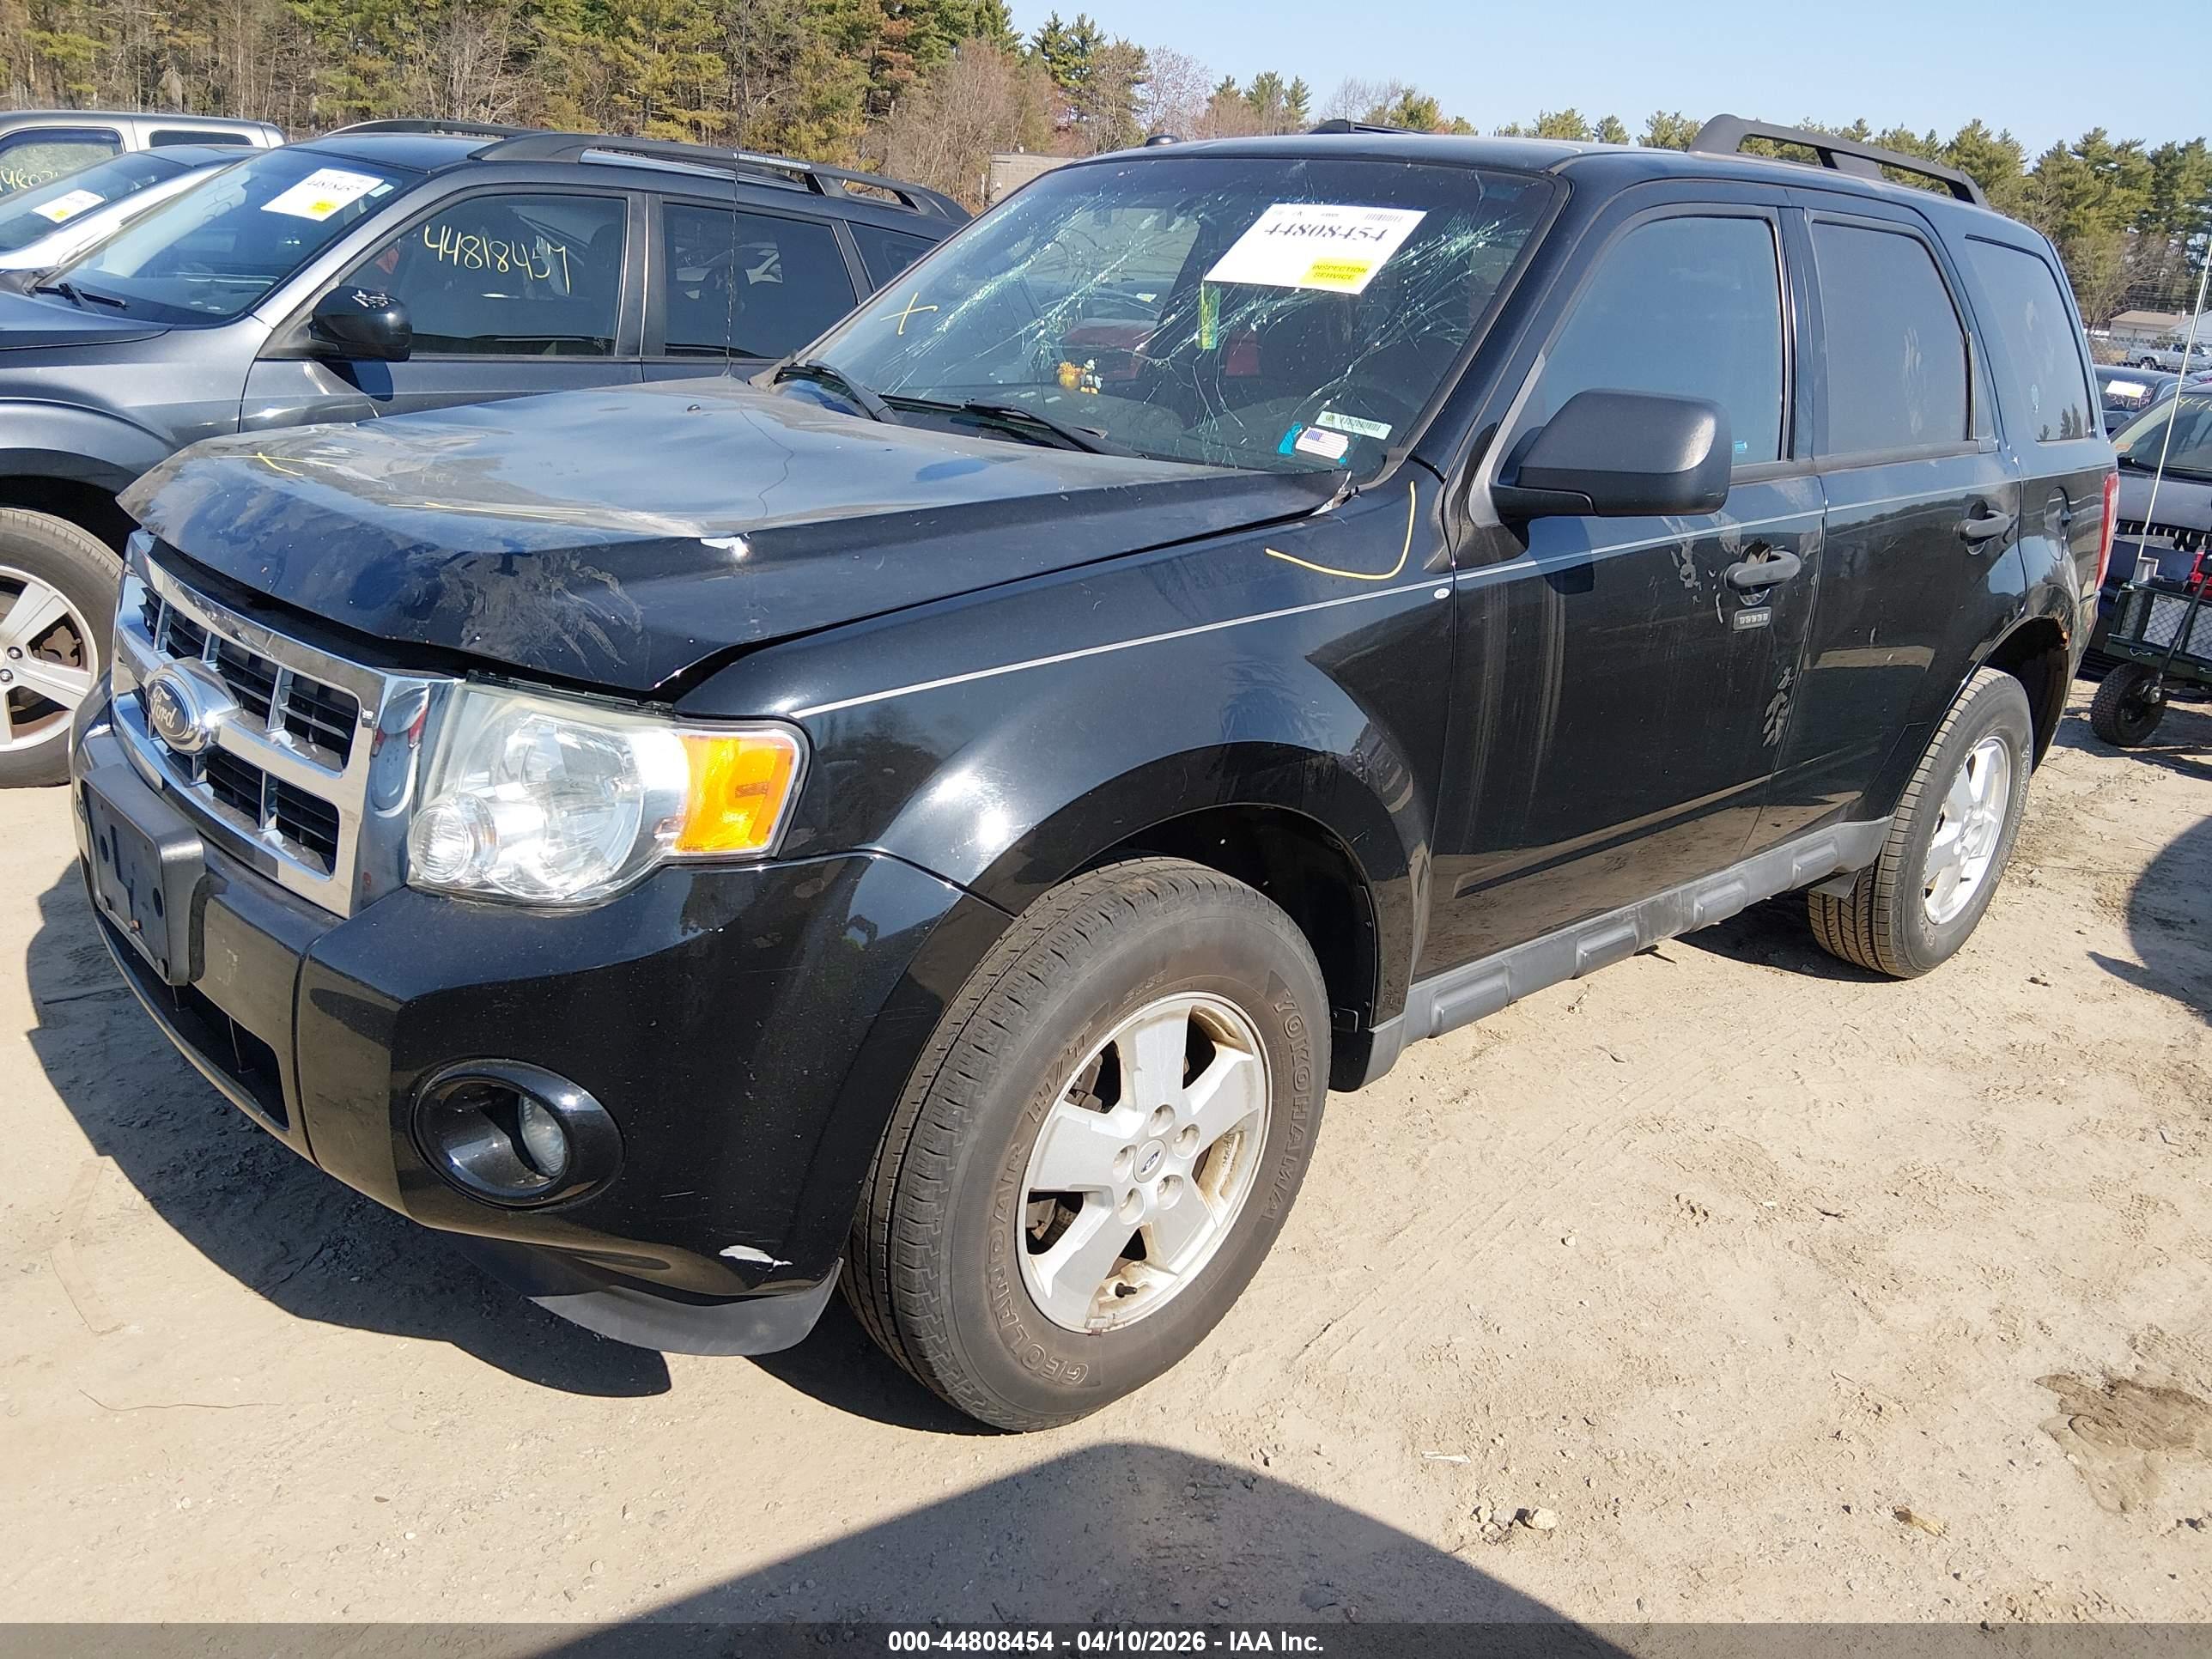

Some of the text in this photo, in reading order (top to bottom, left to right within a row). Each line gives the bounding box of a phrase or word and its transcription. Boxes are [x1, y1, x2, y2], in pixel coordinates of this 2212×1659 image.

[1264, 222, 1389, 241] 44808454
[1312, 264, 1368, 274] INSPECTION
[1313, 272, 1355, 281] SERVICE
[150, 685, 178, 729] Ford
[1267, 990, 1311, 1221] YOKOHAMA
[986, 1141, 1089, 1386] GEOLANDAR
